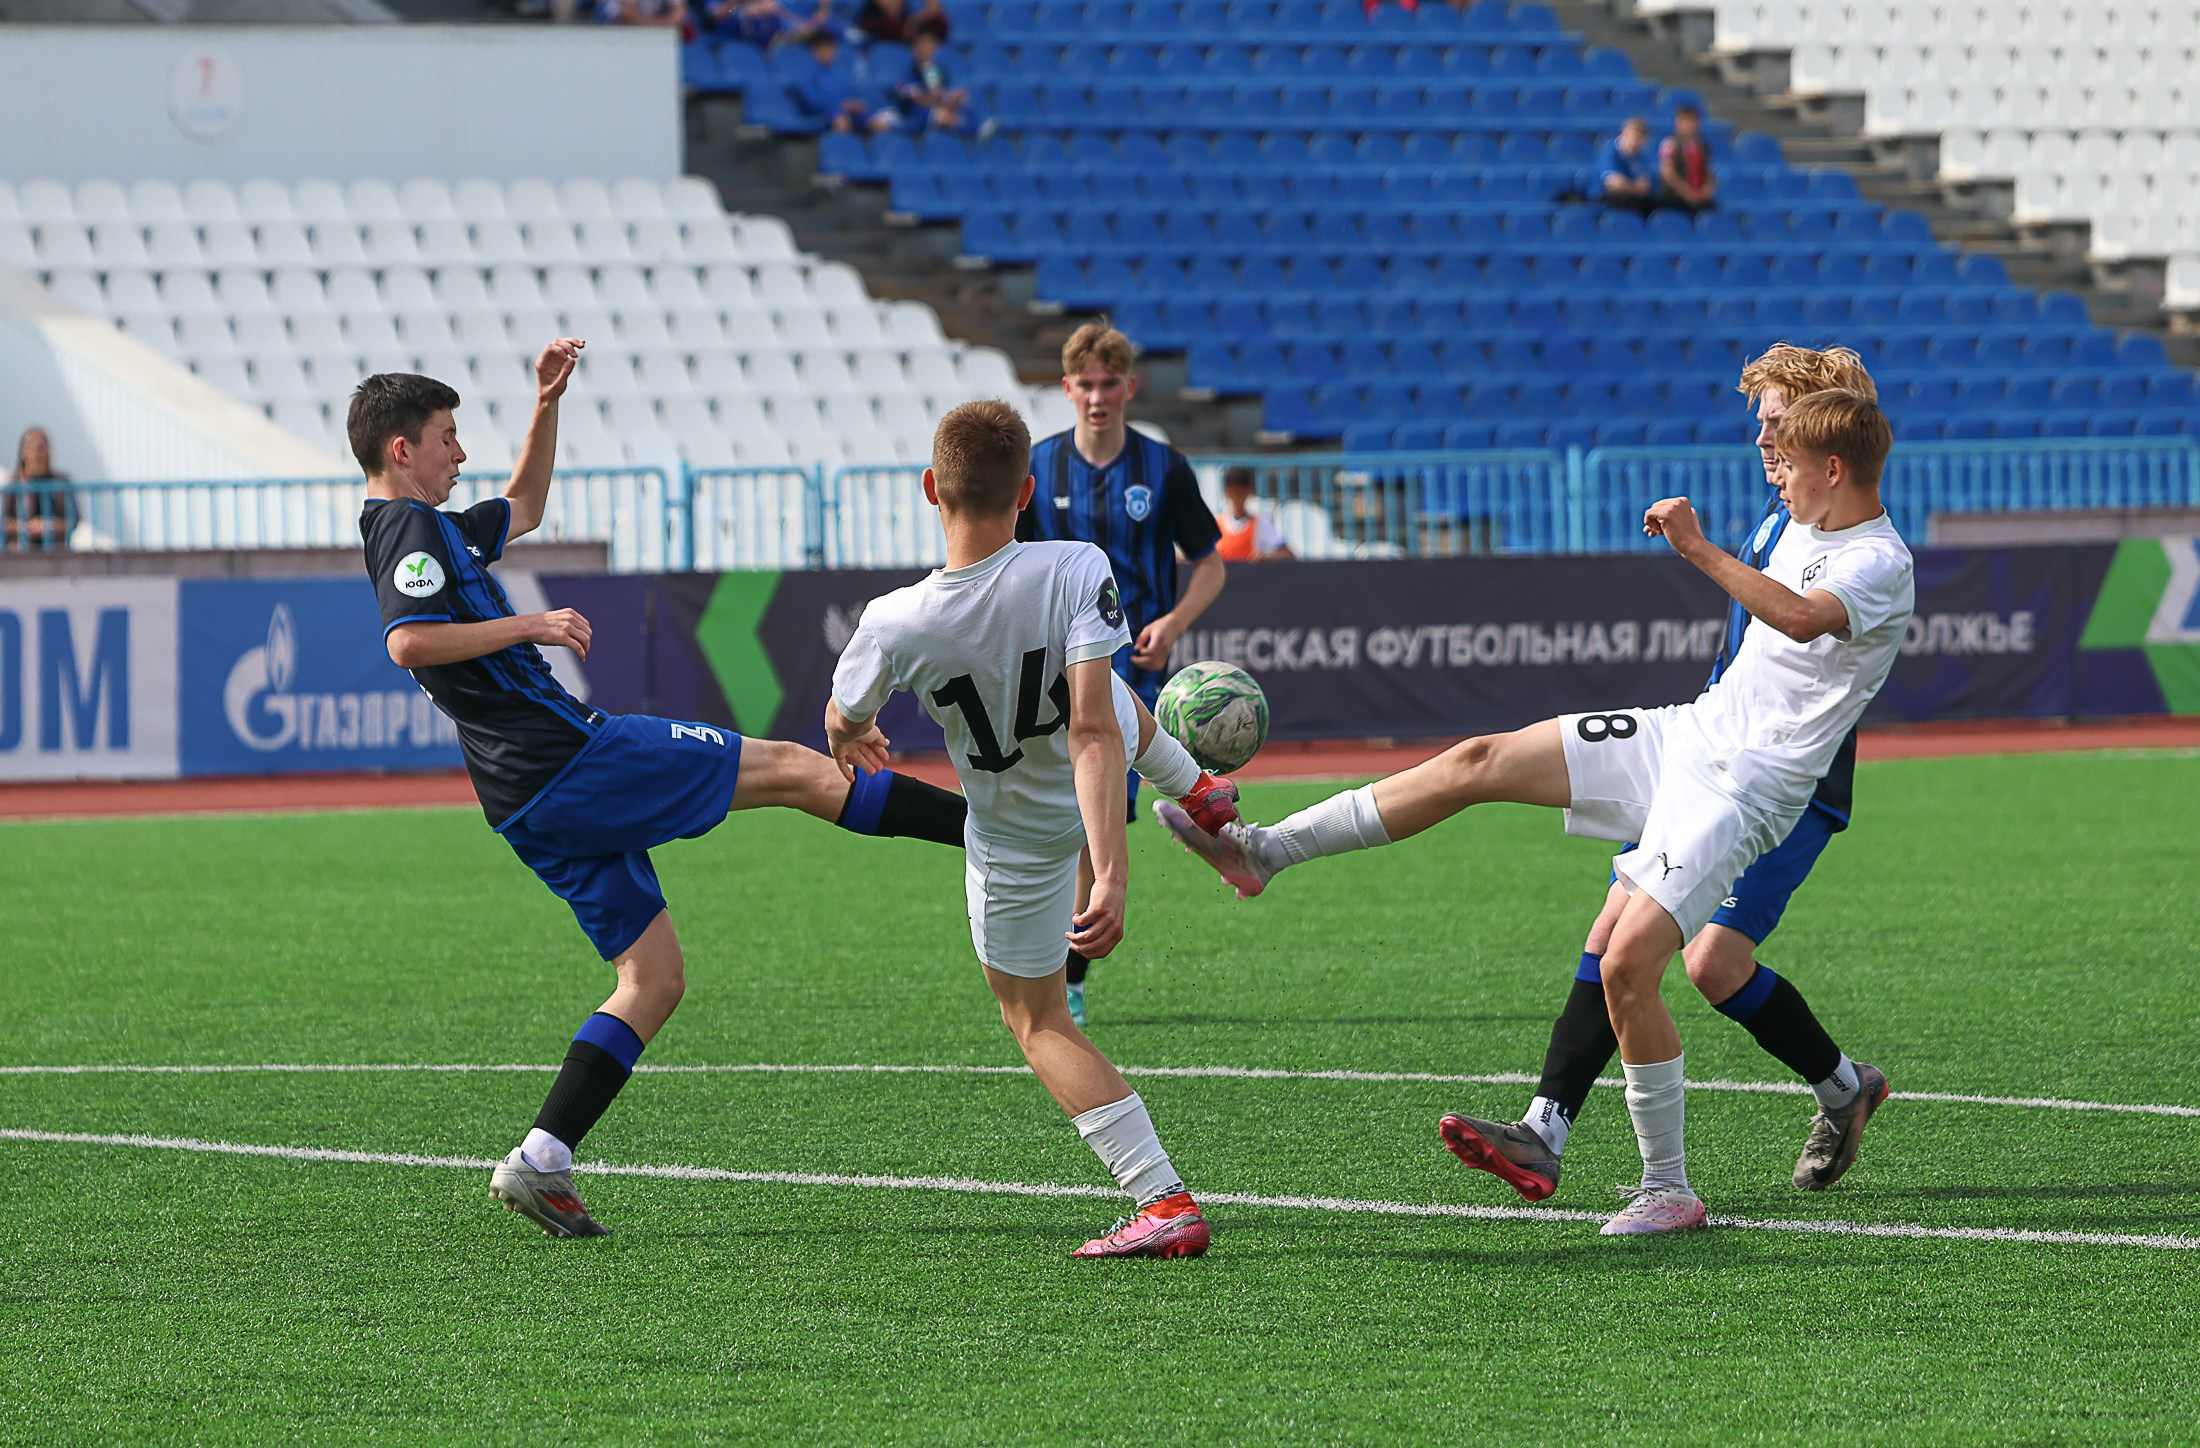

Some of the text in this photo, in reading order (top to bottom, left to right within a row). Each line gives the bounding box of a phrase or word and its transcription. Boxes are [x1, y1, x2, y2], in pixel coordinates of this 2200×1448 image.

[405, 579, 434, 589] ЮФЛ
[1366, 621, 1640, 668] ФУТБОЛЬНАЯ
[1642, 619, 1724, 662] ЛИГ
[930, 647, 1071, 774] 14
[670, 722, 724, 746] 3
[1577, 713, 1637, 743] 8
